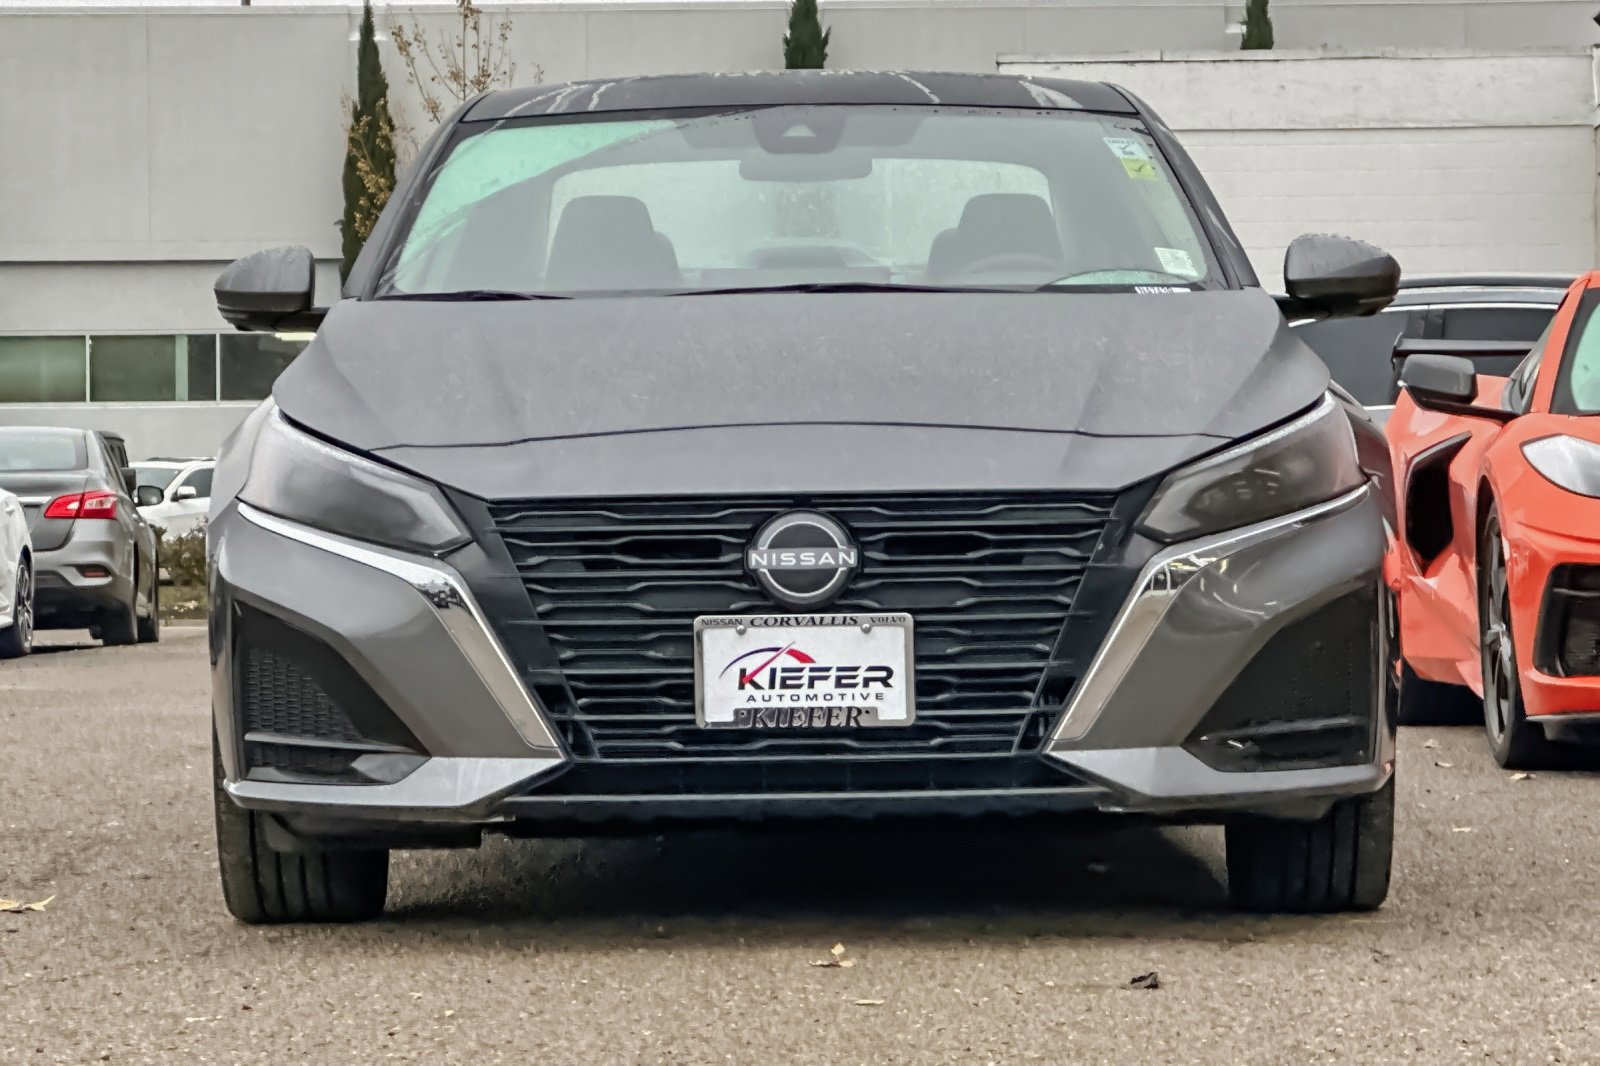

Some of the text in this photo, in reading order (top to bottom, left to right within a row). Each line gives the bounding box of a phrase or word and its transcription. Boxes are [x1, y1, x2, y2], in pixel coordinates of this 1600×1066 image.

[752, 551, 855, 566] NISSAN
[701, 615, 906, 627] NISSAN CORVALLIS VOLVO
[738, 665, 894, 690] KIEFER
[746, 692, 884, 703] AUTOMOTIVE
[750, 706, 863, 728] KIEFER
